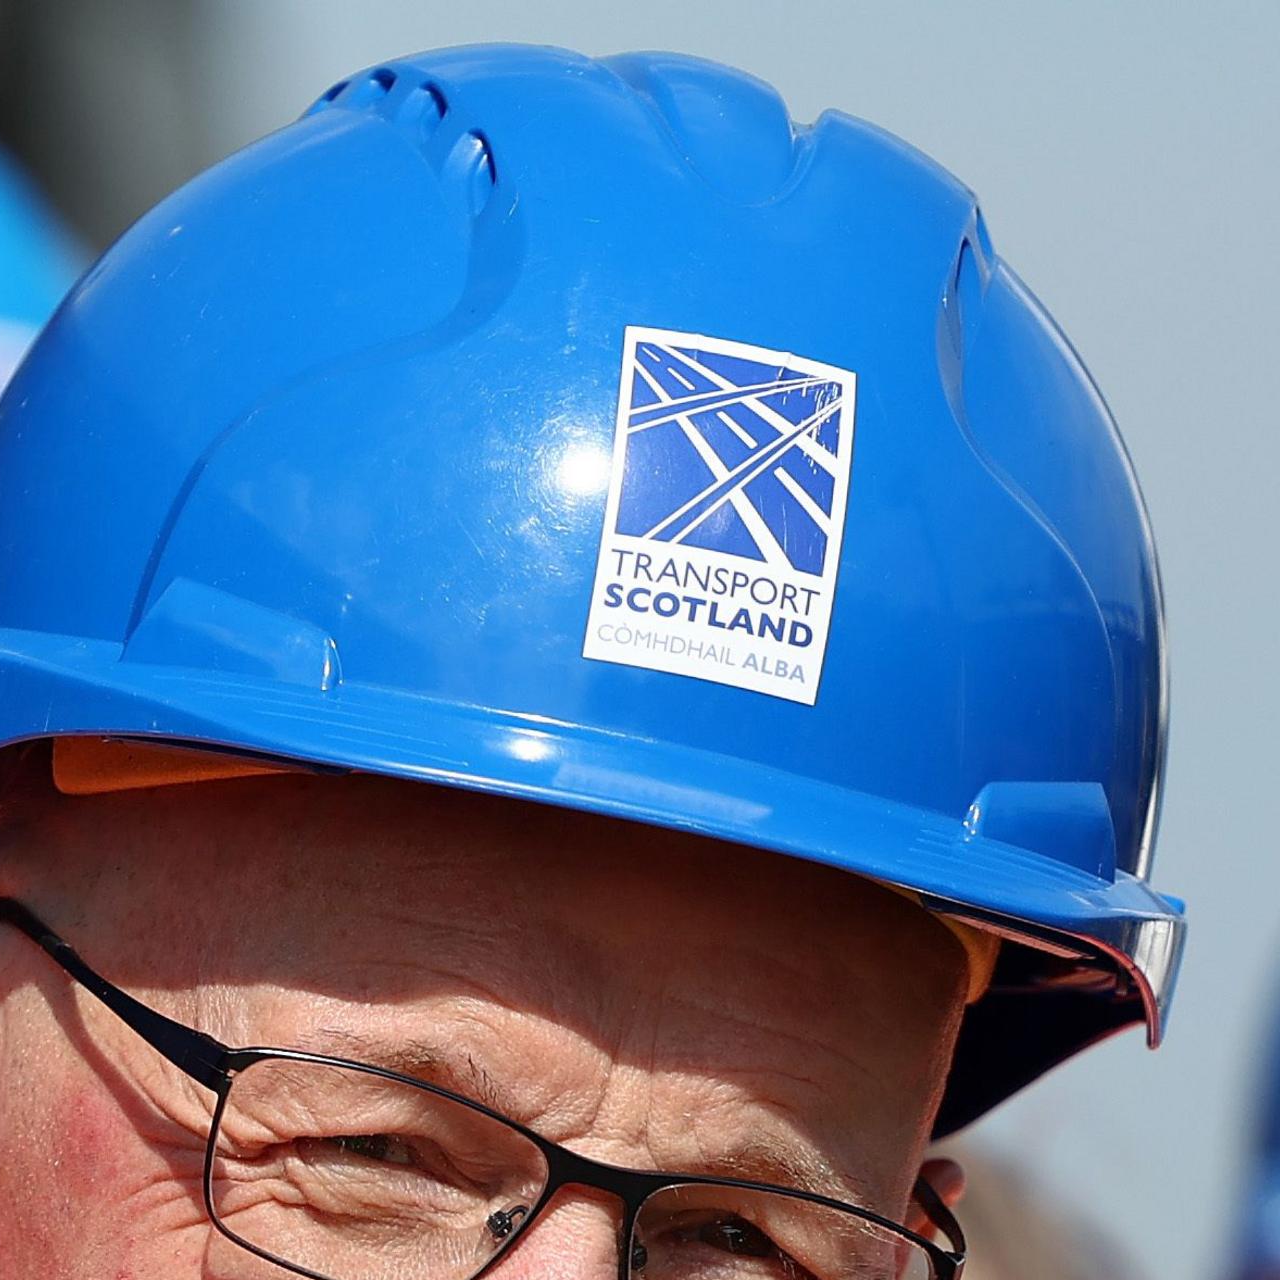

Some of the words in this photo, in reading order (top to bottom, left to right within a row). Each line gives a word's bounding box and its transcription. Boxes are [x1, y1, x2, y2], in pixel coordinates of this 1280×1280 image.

[611, 548, 820, 616] TRANSPORT
[604, 583, 814, 648] SCOTLAND
[597, 622, 736, 666] CÒMHDHAIL
[741, 652, 806, 684] ALBA
